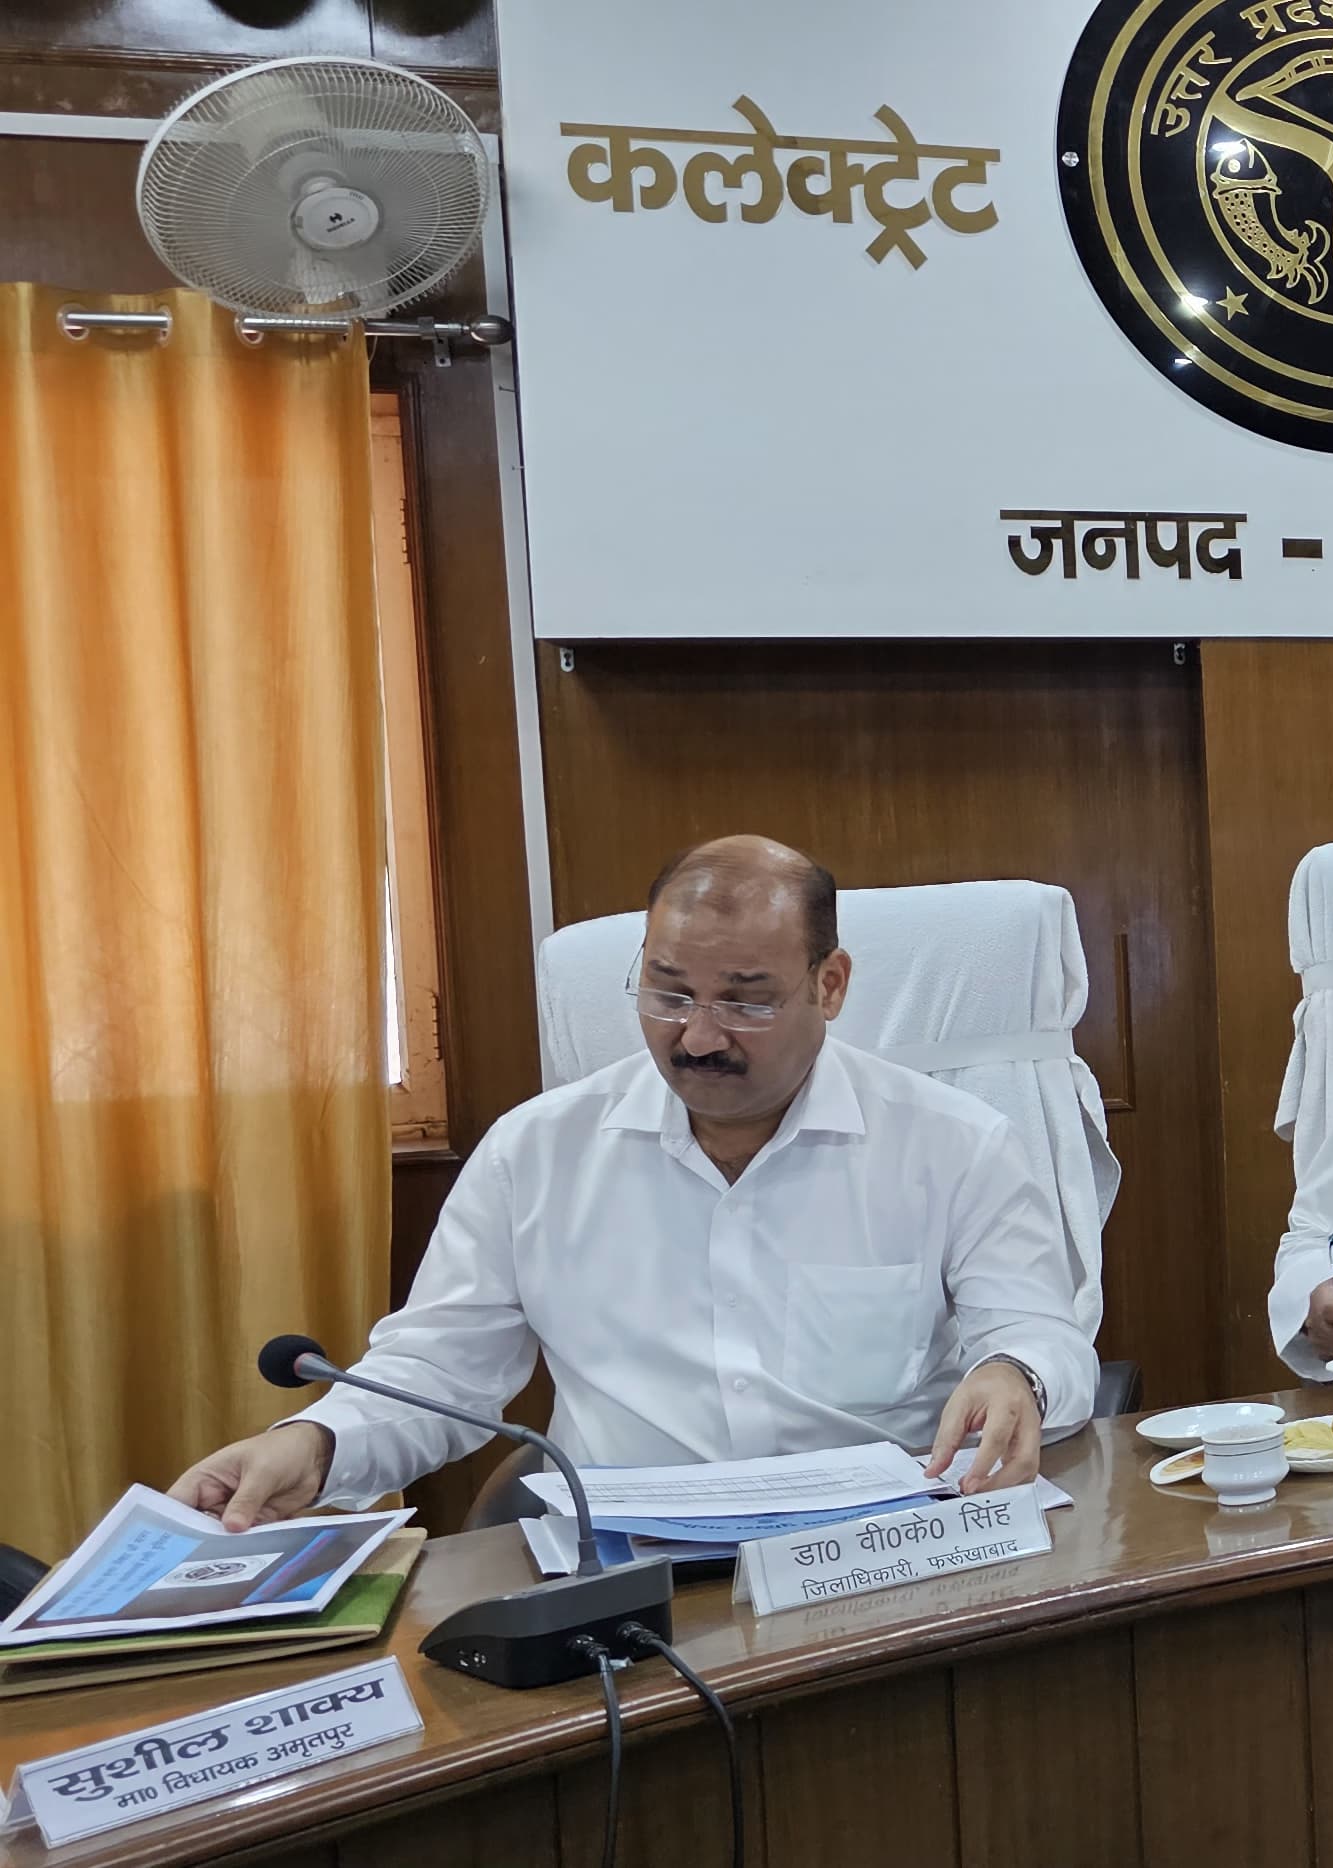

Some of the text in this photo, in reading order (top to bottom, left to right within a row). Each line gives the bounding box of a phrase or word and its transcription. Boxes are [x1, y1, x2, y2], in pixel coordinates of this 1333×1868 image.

[1151, 31, 1232, 137] उत्तर
[560, 95, 1000, 270] कलेक्ट्रेट
[1000, 509, 1248, 580] जनपद
[959, 1499, 1011, 1533] सिंह
[801, 1559, 919, 1600] जिलाधिकारी,
[48, 1678, 385, 1802] सुशील शाक्य
[163, 1752, 259, 1795] विधायक
[266, 1722, 354, 1761] अमृतपुर
